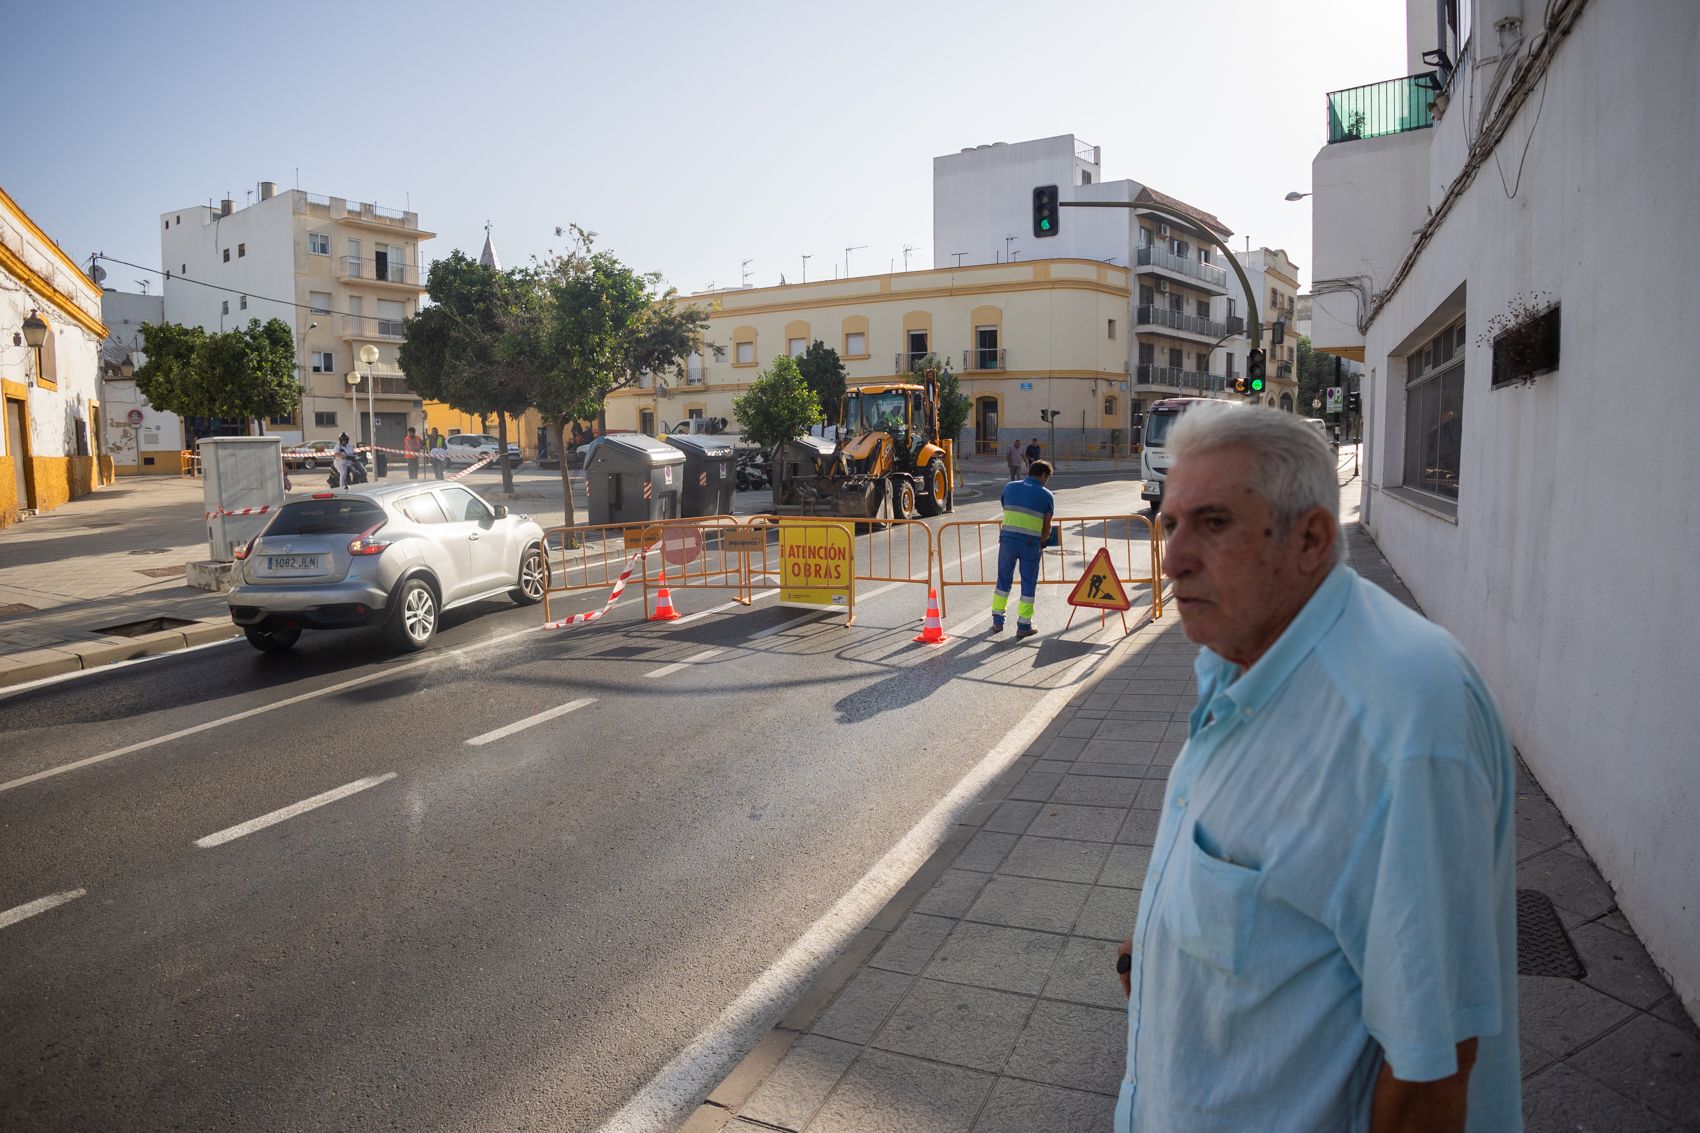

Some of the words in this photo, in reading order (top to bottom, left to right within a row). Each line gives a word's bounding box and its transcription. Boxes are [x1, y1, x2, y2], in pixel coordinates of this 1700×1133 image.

[275, 558, 296, 568] 1082
[299, 557, 316, 568] JLN
[791, 562, 842, 580] OBRAS
